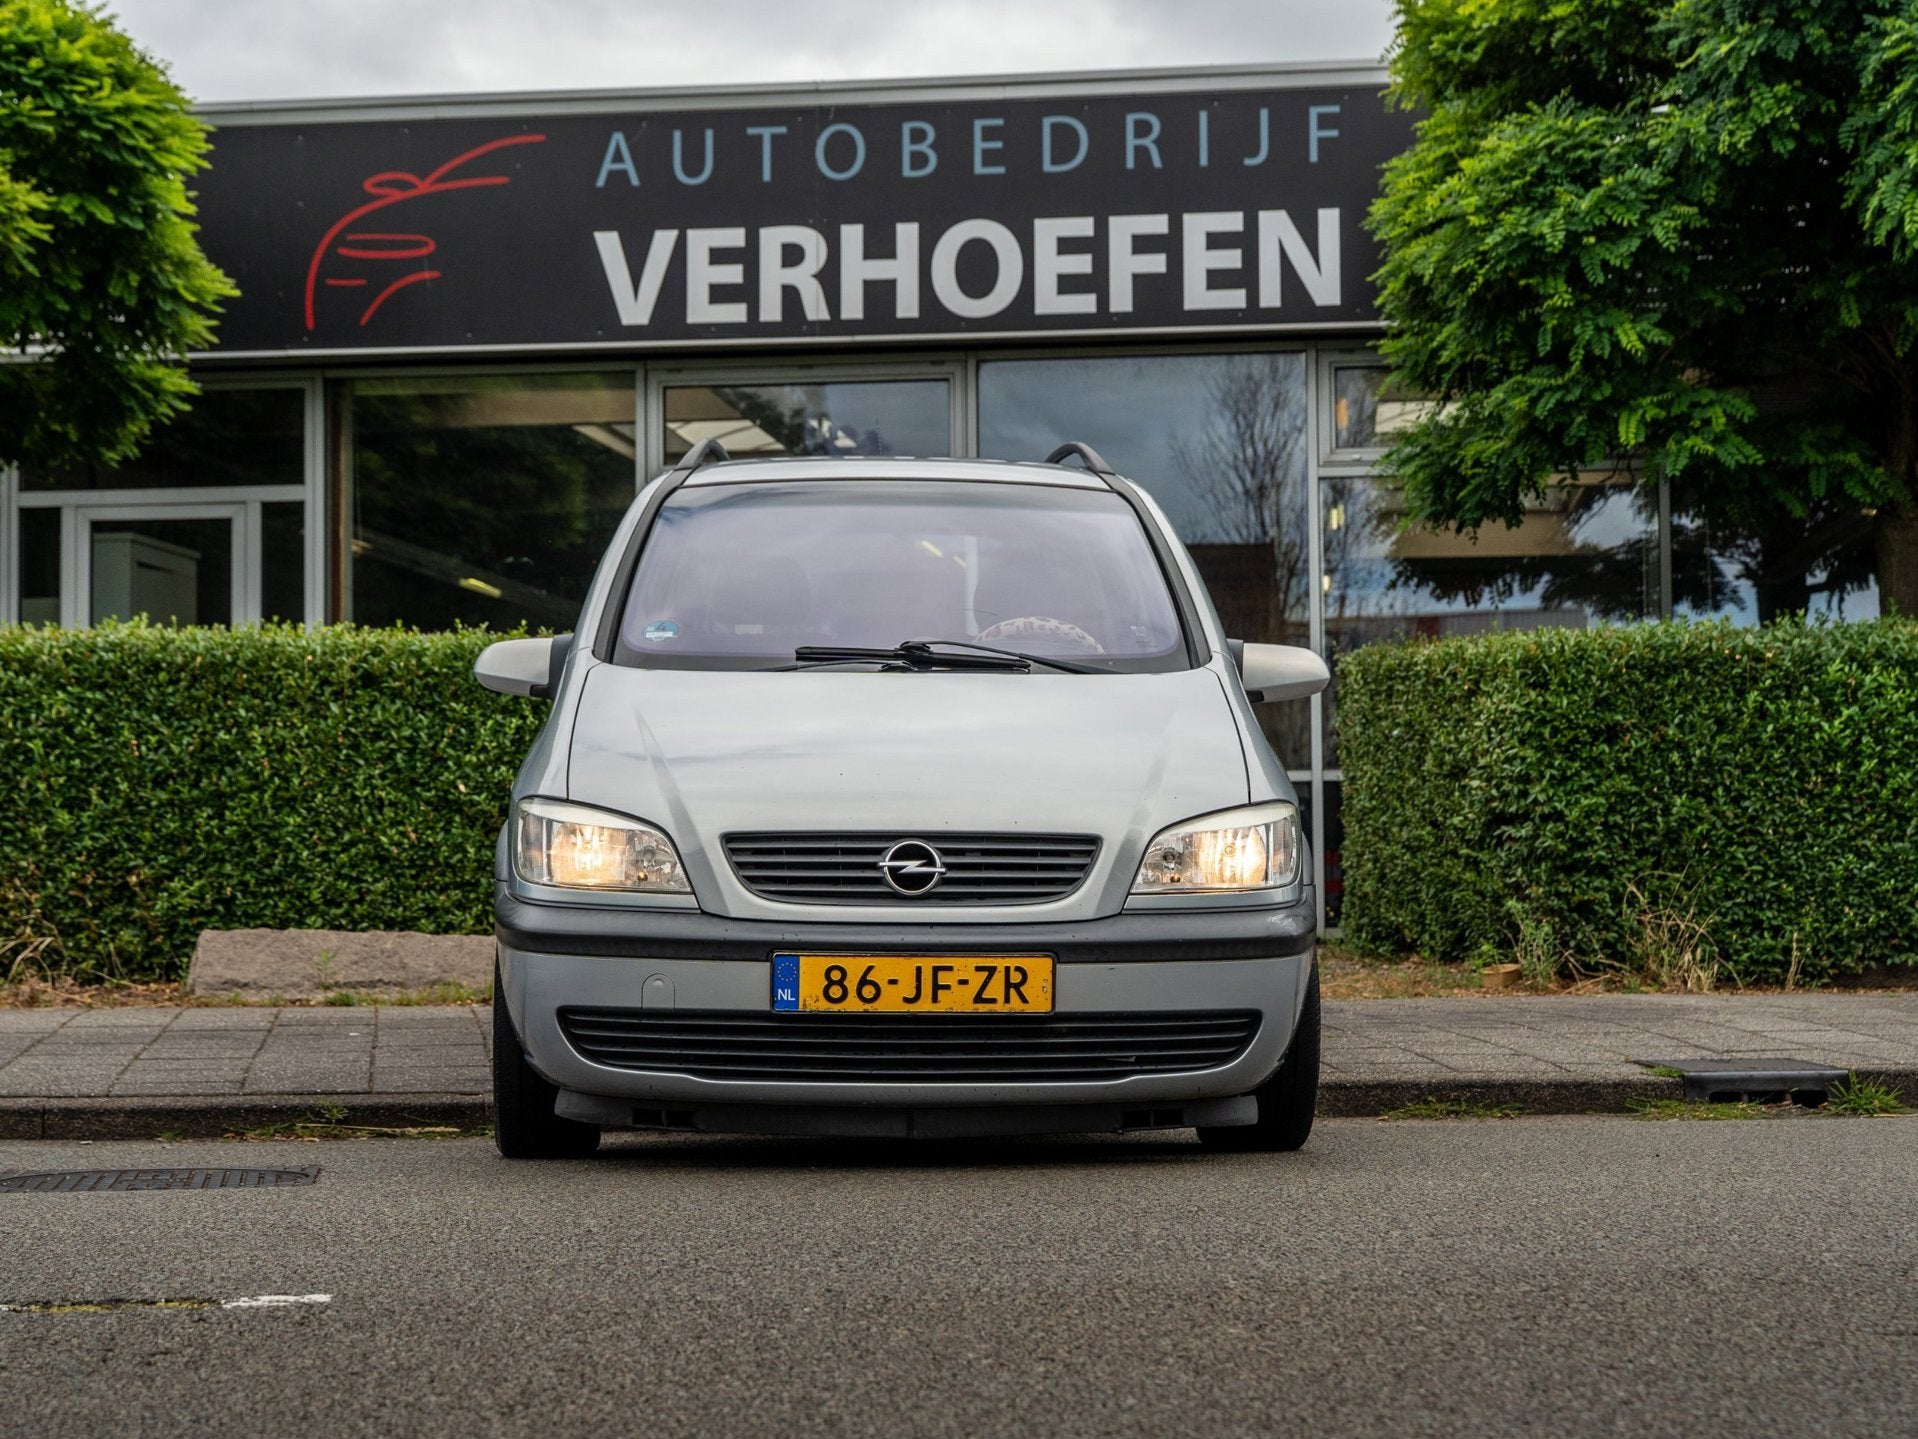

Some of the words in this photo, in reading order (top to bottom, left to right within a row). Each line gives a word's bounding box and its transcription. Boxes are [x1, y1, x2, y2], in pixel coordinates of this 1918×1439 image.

[595, 104, 1341, 188] AUTOBEDRIJF
[593, 207, 1341, 326] VERHOEFEN
[777, 988, 796, 1001] NL
[822, 964, 1030, 1005] 86-JF-ZR
